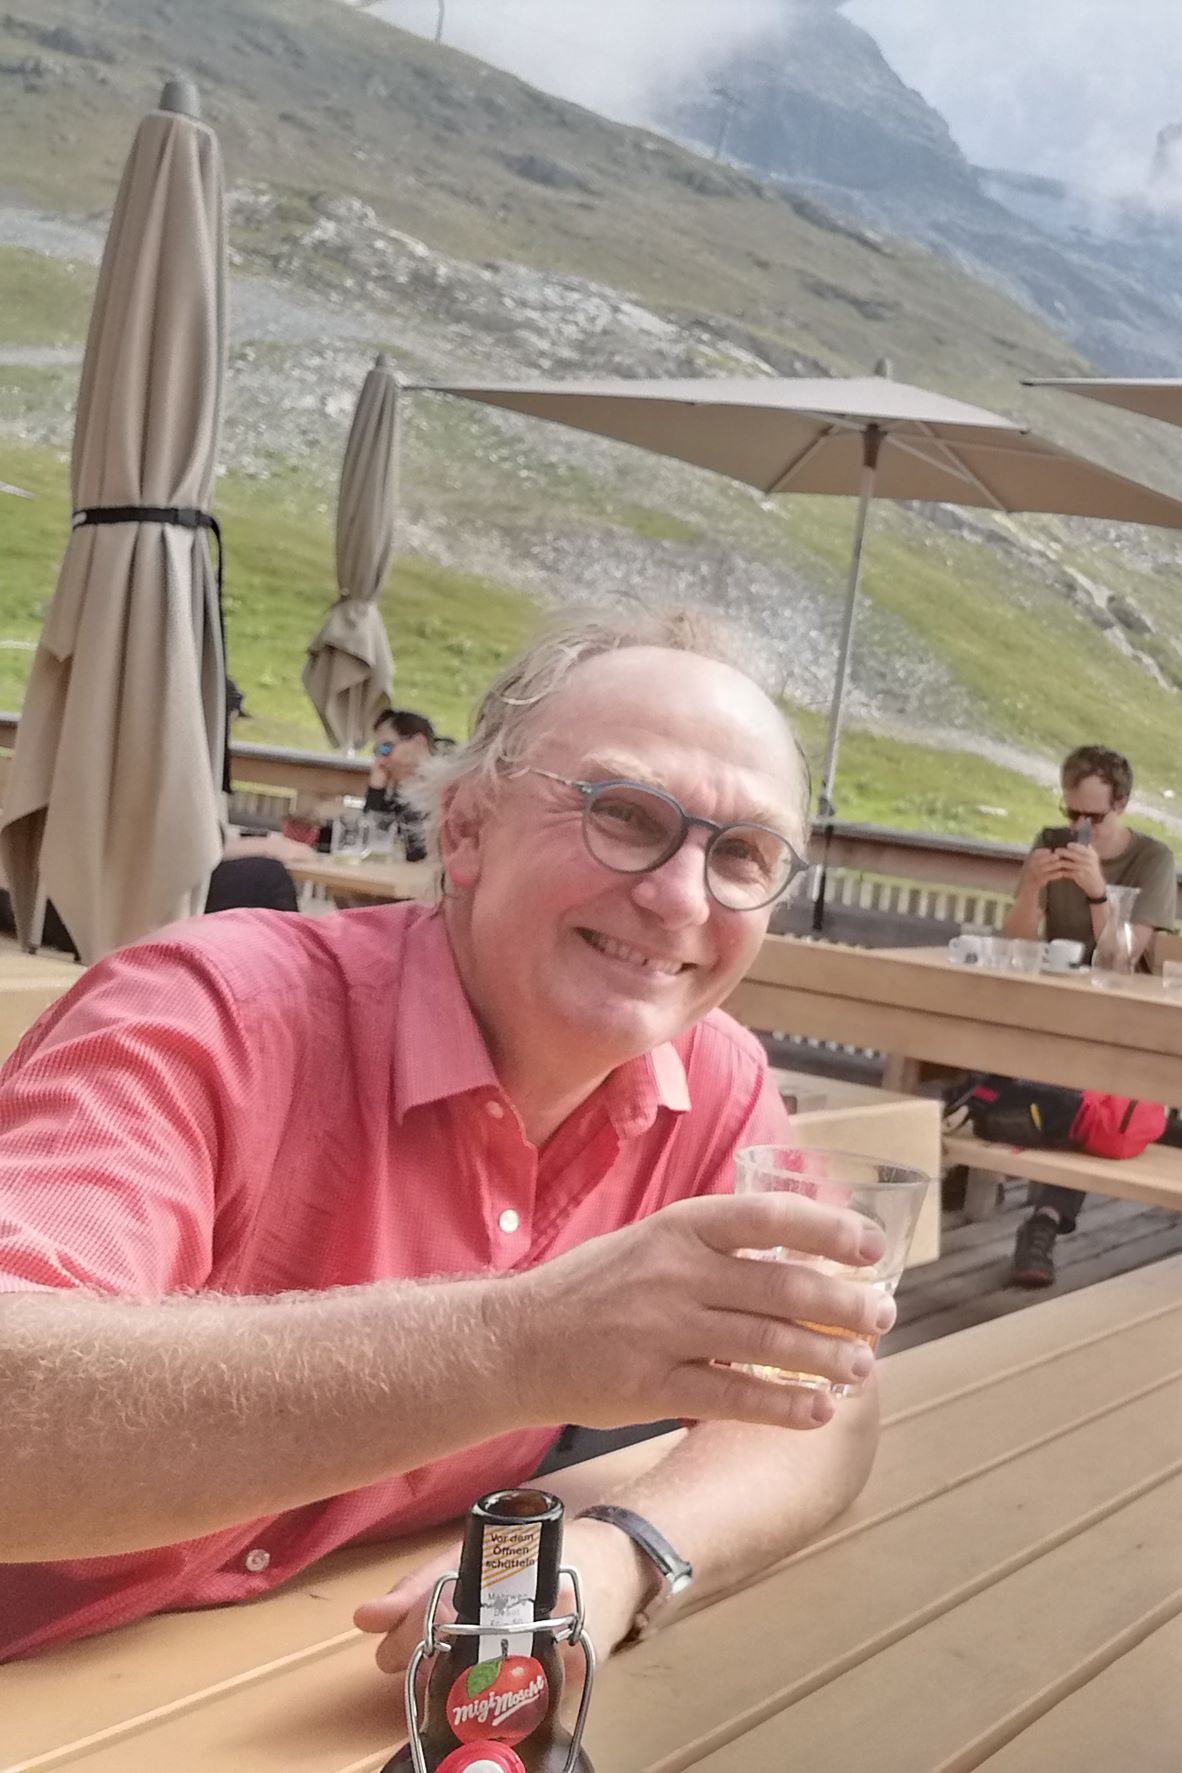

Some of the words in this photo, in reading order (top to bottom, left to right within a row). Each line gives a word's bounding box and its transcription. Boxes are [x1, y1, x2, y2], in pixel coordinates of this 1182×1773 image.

[491, 1533, 507, 1542] Vor
[509, 1533, 534, 1542] dem
[493, 1545, 530, 1556] Öffnen
[486, 1558, 536, 1569] schütteln
